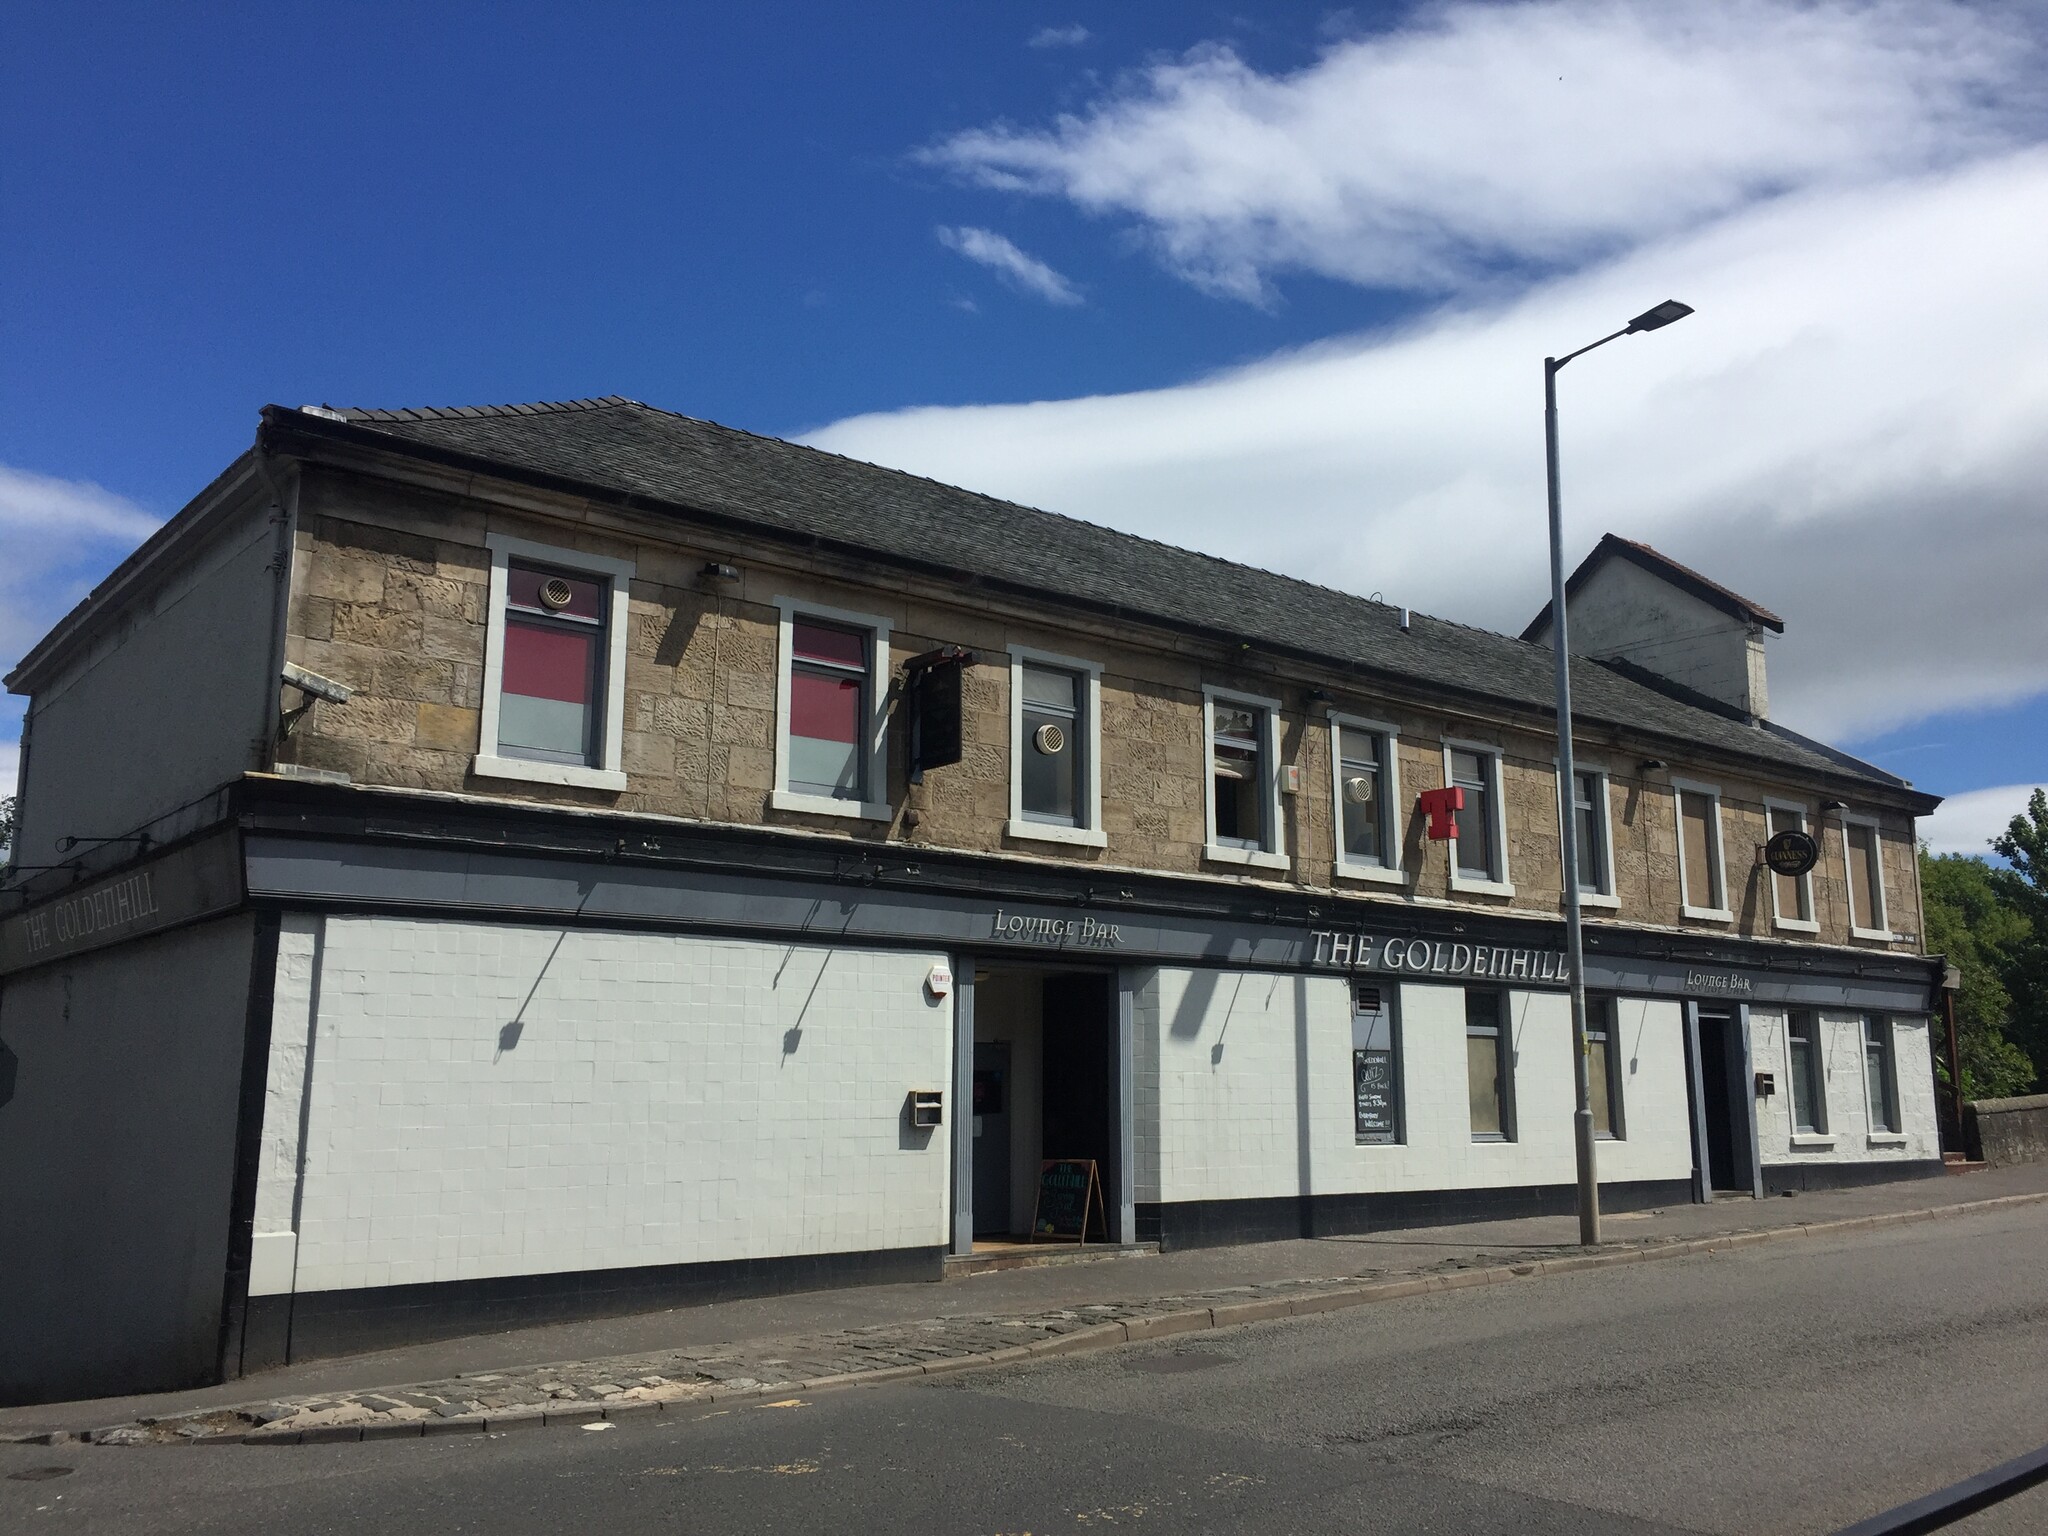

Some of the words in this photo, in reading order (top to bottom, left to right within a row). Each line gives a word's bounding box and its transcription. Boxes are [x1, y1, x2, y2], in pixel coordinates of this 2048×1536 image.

[1770, 850, 1808, 861] GUINNESS
[23, 912, 51, 952] THE
[55, 871, 159, 943] GOLDENHILL
[1310, 929, 1374, 966] THE
[1383, 937, 1570, 981] GOLDENHILL
